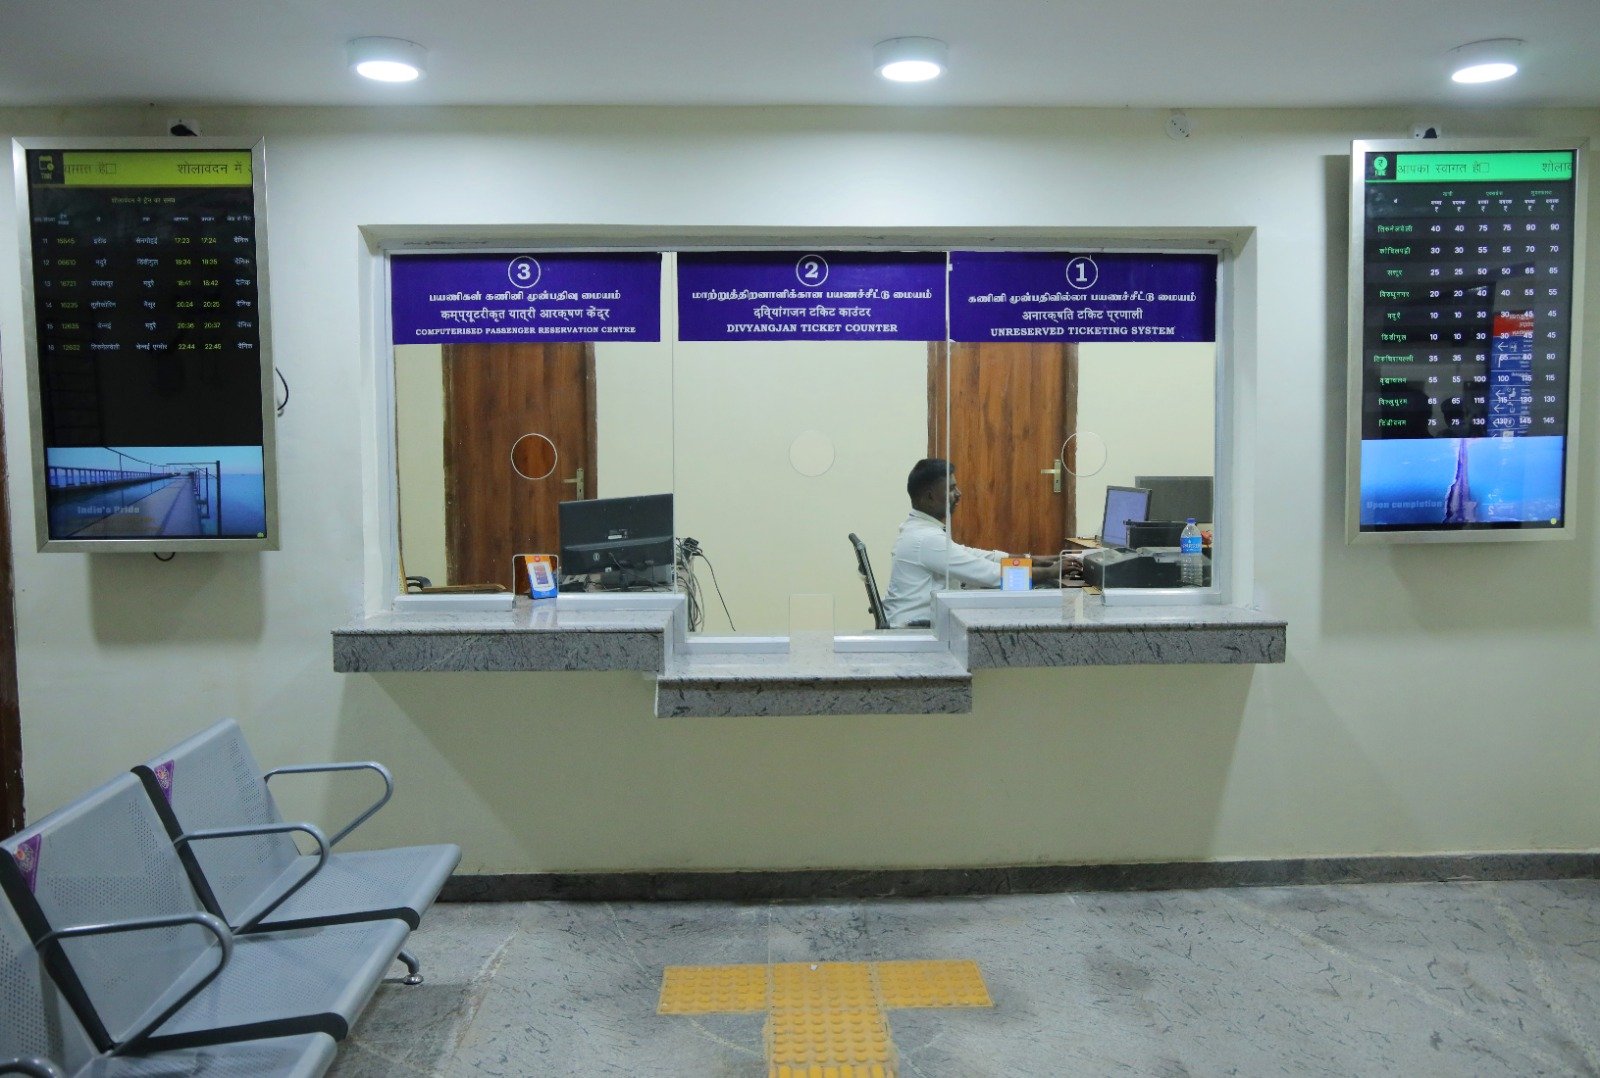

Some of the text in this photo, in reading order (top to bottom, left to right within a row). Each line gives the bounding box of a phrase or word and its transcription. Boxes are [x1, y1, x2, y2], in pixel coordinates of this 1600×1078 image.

[1398, 164, 1429, 174] आपका
[1435, 163, 1467, 174] स्वागत
[1479, 224, 1488, 232] 75
[1526, 245, 1535, 253] 70
[517, 263, 531, 280] 3
[805, 263, 819, 279] 2
[1076, 263, 1087, 282] 1
[429, 290, 621, 302] பயணிகள் கணினி முன்பதிவு மையம்
[827, 288, 890, 299] பயணச்சீட்டு
[893, 288, 932, 298] மையம்
[968, 291, 1196, 304] கணினி முன்பதிவில்லா பயணச்சீட்டு மையம்
[1548, 288, 1558, 296] 55
[838, 306, 871, 317] काउंटर
[1106, 307, 1143, 323] प्रणाली
[416, 328, 483, 336] COMPUTERISED
[727, 324, 898, 332] DIVYANGJAN TICKET COUNTER
[990, 326, 1175, 337] UNRESERVED TICKETING SYSTEM
[1547, 331, 1556, 339] 45
